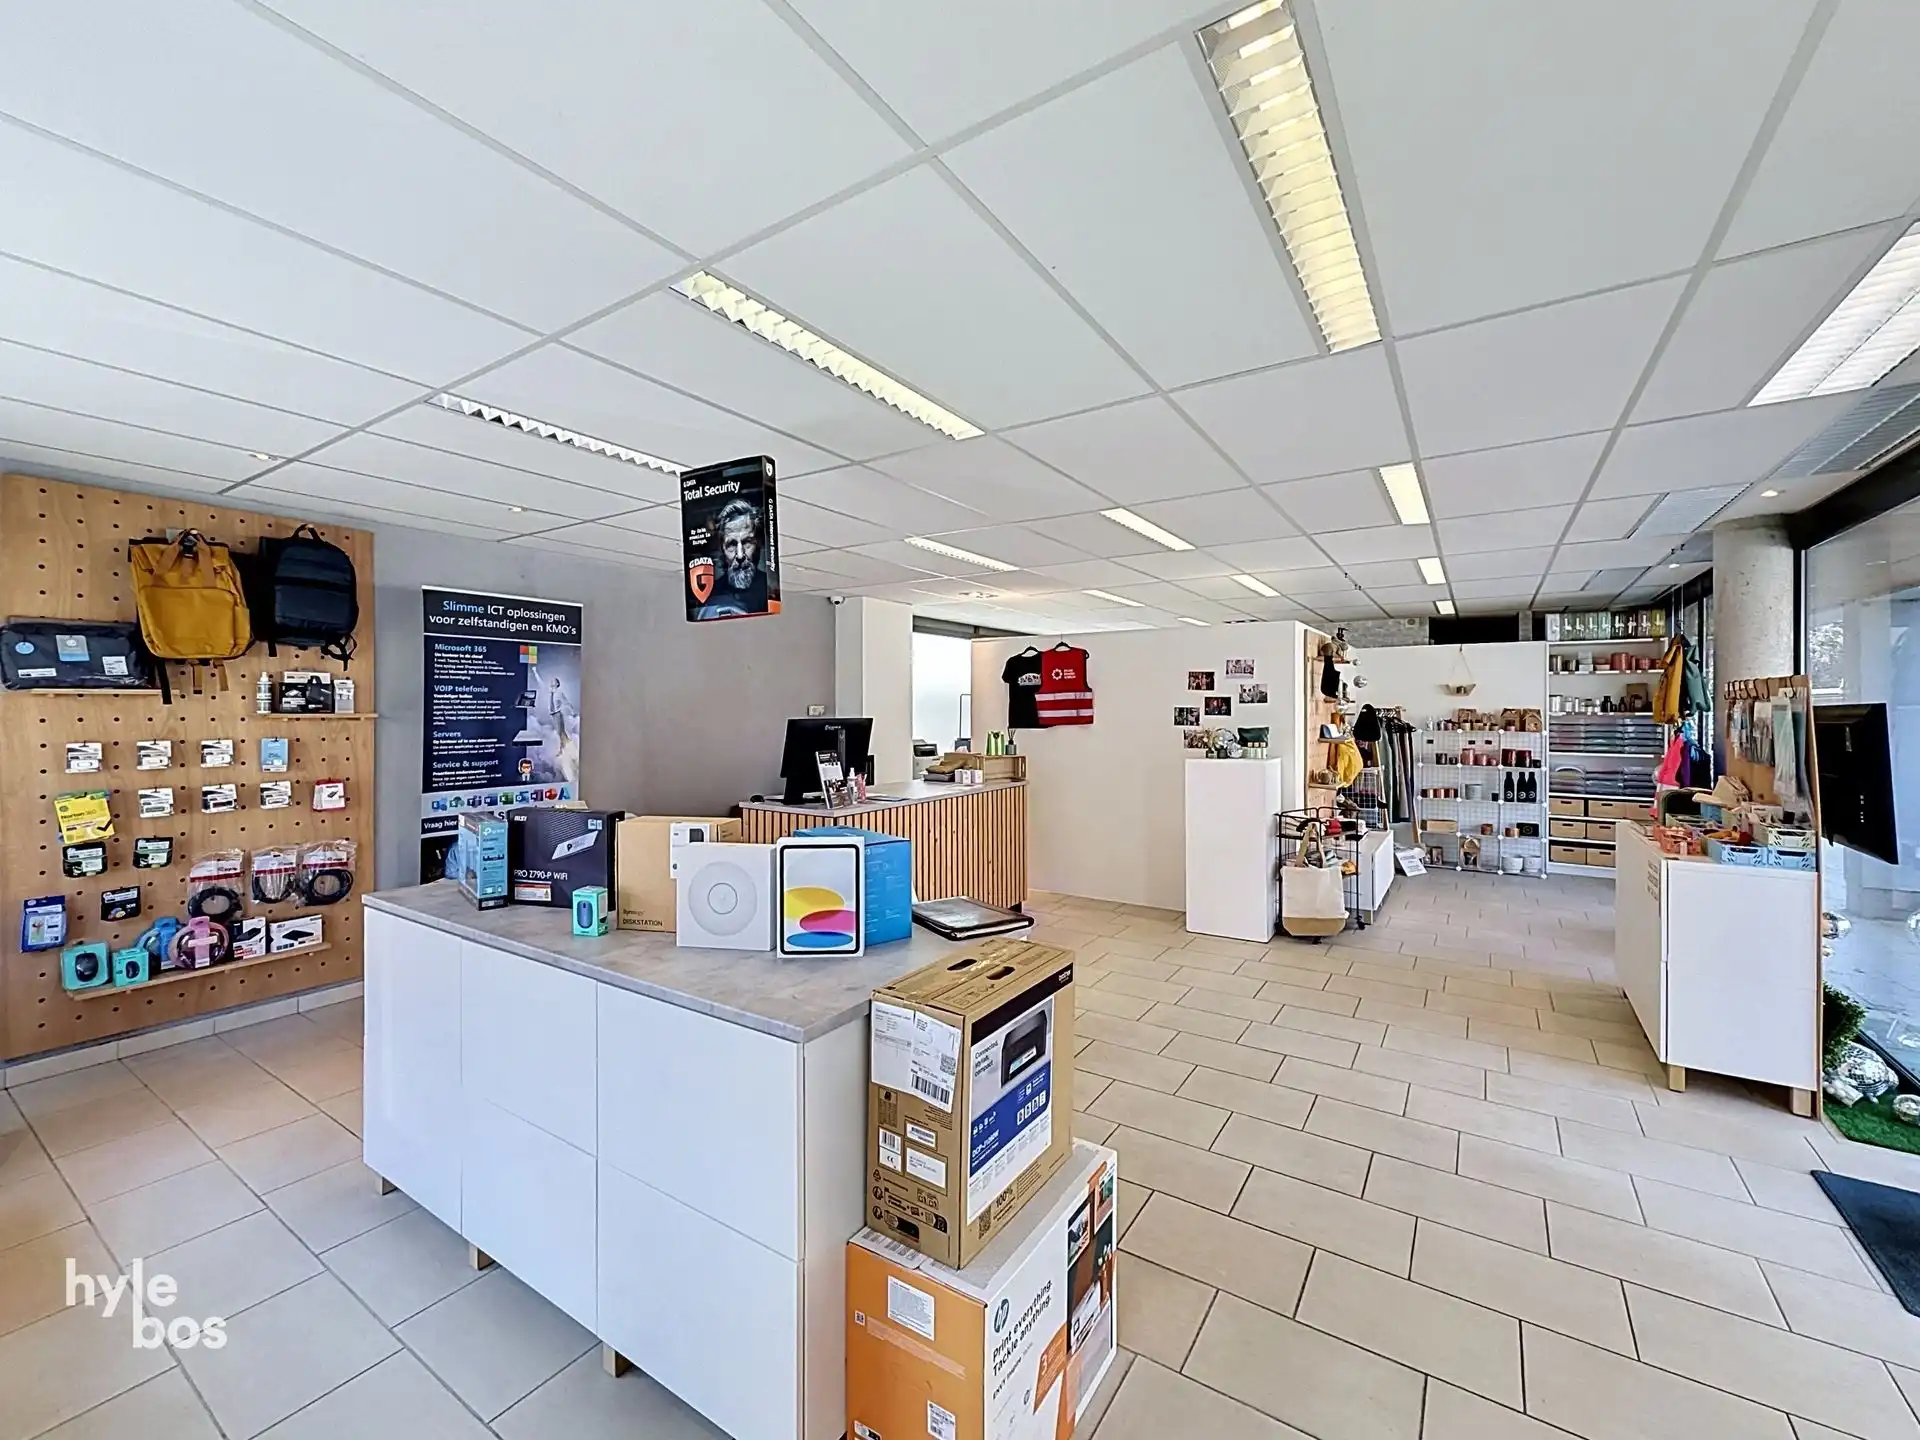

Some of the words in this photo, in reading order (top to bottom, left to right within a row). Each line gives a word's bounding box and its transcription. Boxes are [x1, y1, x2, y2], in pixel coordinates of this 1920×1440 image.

[684, 487, 703, 501] Total
[704, 481, 740, 497] Security
[443, 600, 485, 613] Slimme
[487, 605, 504, 615] ICT
[507, 608, 566, 622] oplossingen
[429, 615, 455, 624] voor
[457, 616, 529, 632] zelfstandigen
[546, 624, 577, 635] KMO's
[434, 643, 472, 652] Microsoft
[471, 760, 498, 768] support
[424, 822, 443, 830] Vraag
[514, 869, 528, 877] PRO
[529, 870, 552, 880] Z790-P
[993, 1331, 1012, 1363] Print
[1013, 1280, 1053, 1335] everything.
[993, 1342, 1019, 1377] Tackle
[1019, 1294, 1052, 1341] anything.
[1040, 1355, 1048, 1376] 3
